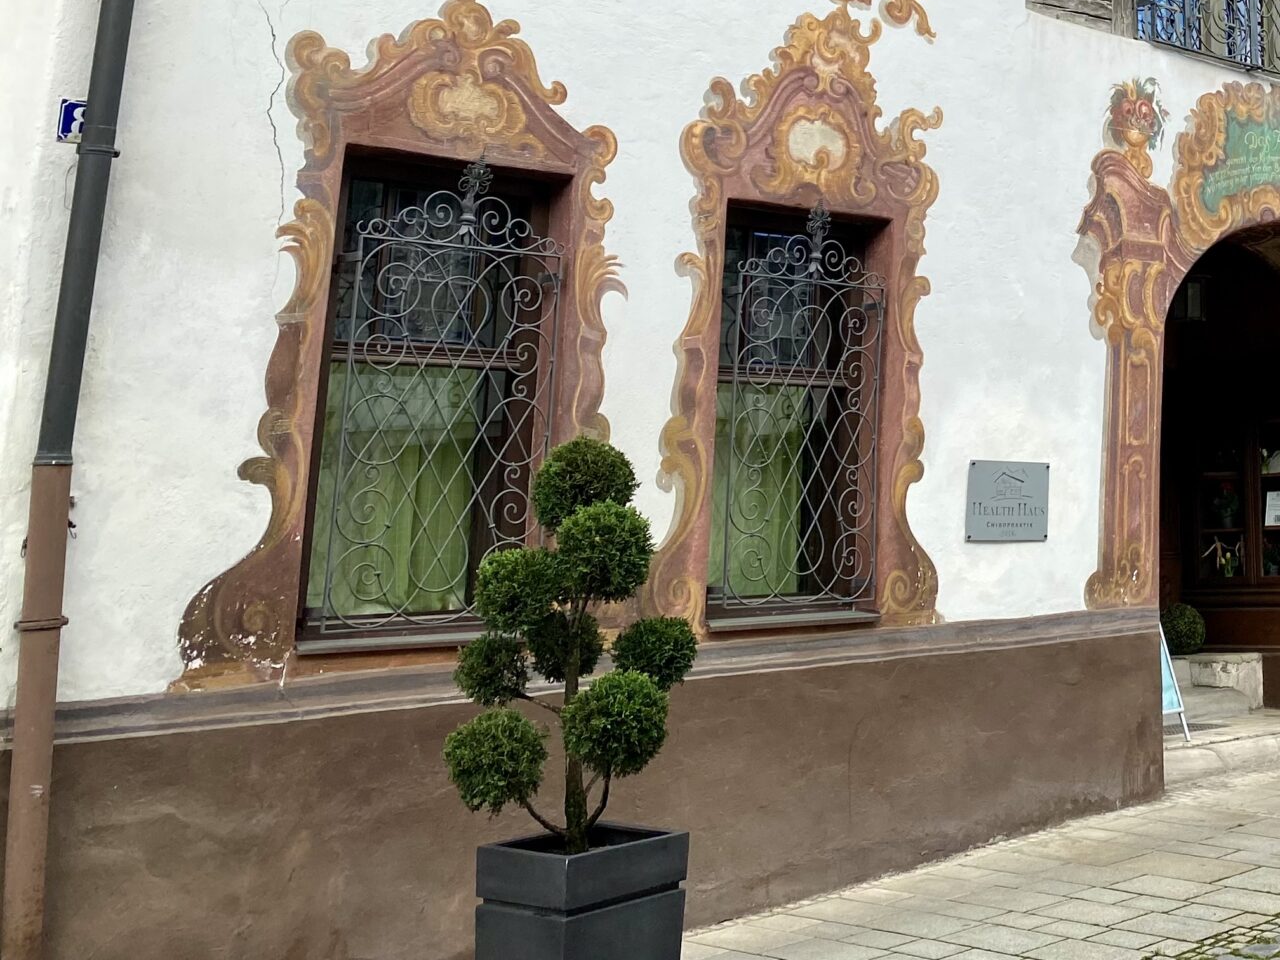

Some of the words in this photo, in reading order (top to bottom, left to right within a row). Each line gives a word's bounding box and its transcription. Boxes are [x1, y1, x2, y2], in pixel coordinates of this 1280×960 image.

[1244, 131, 1270, 153] Das
[972, 502, 1014, 517] HEALTH
[1017, 502, 1045, 517] HAUS
